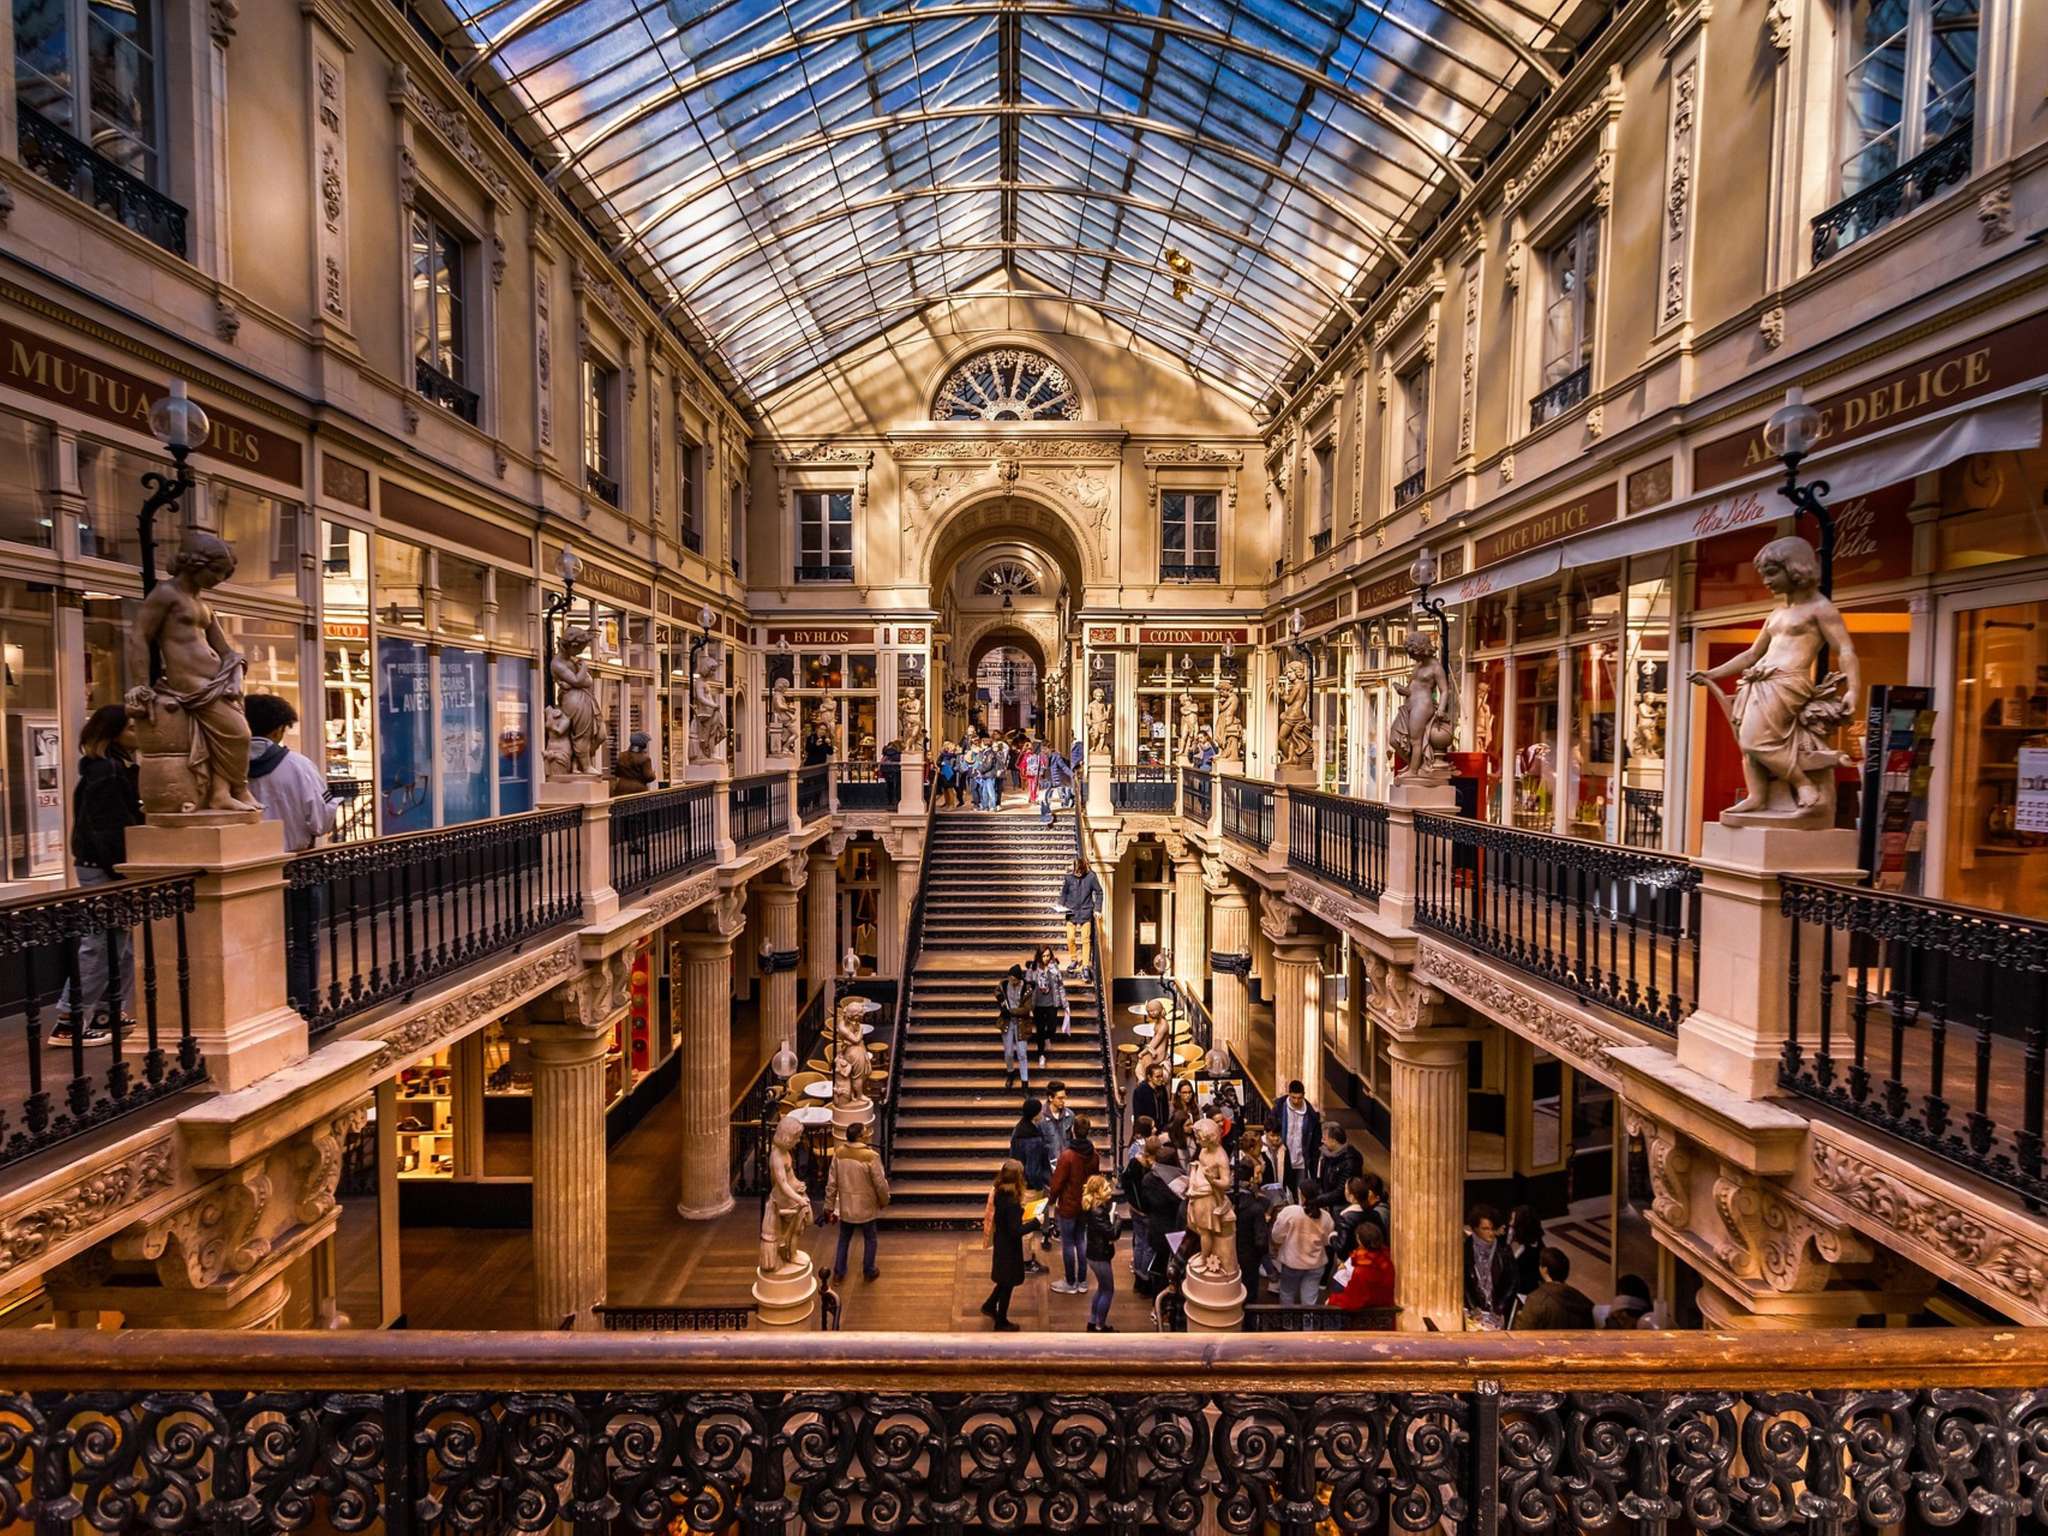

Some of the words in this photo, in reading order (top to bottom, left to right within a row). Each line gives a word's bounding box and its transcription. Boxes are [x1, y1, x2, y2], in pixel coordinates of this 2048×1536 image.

[1843, 347, 1991, 432] DELICE
[9, 340, 260, 463] MUTUATES
[1492, 527, 1529, 557] ALICE
[1533, 504, 1589, 543] DELICE
[583, 566, 600, 586] LES
[794, 631, 849, 643] BYBLOS
[1150, 630, 1193, 642] COTON
[1201, 630, 1237, 643] DOUX
[413, 677, 429, 692] DES
[403, 693, 429, 713] AVEC
